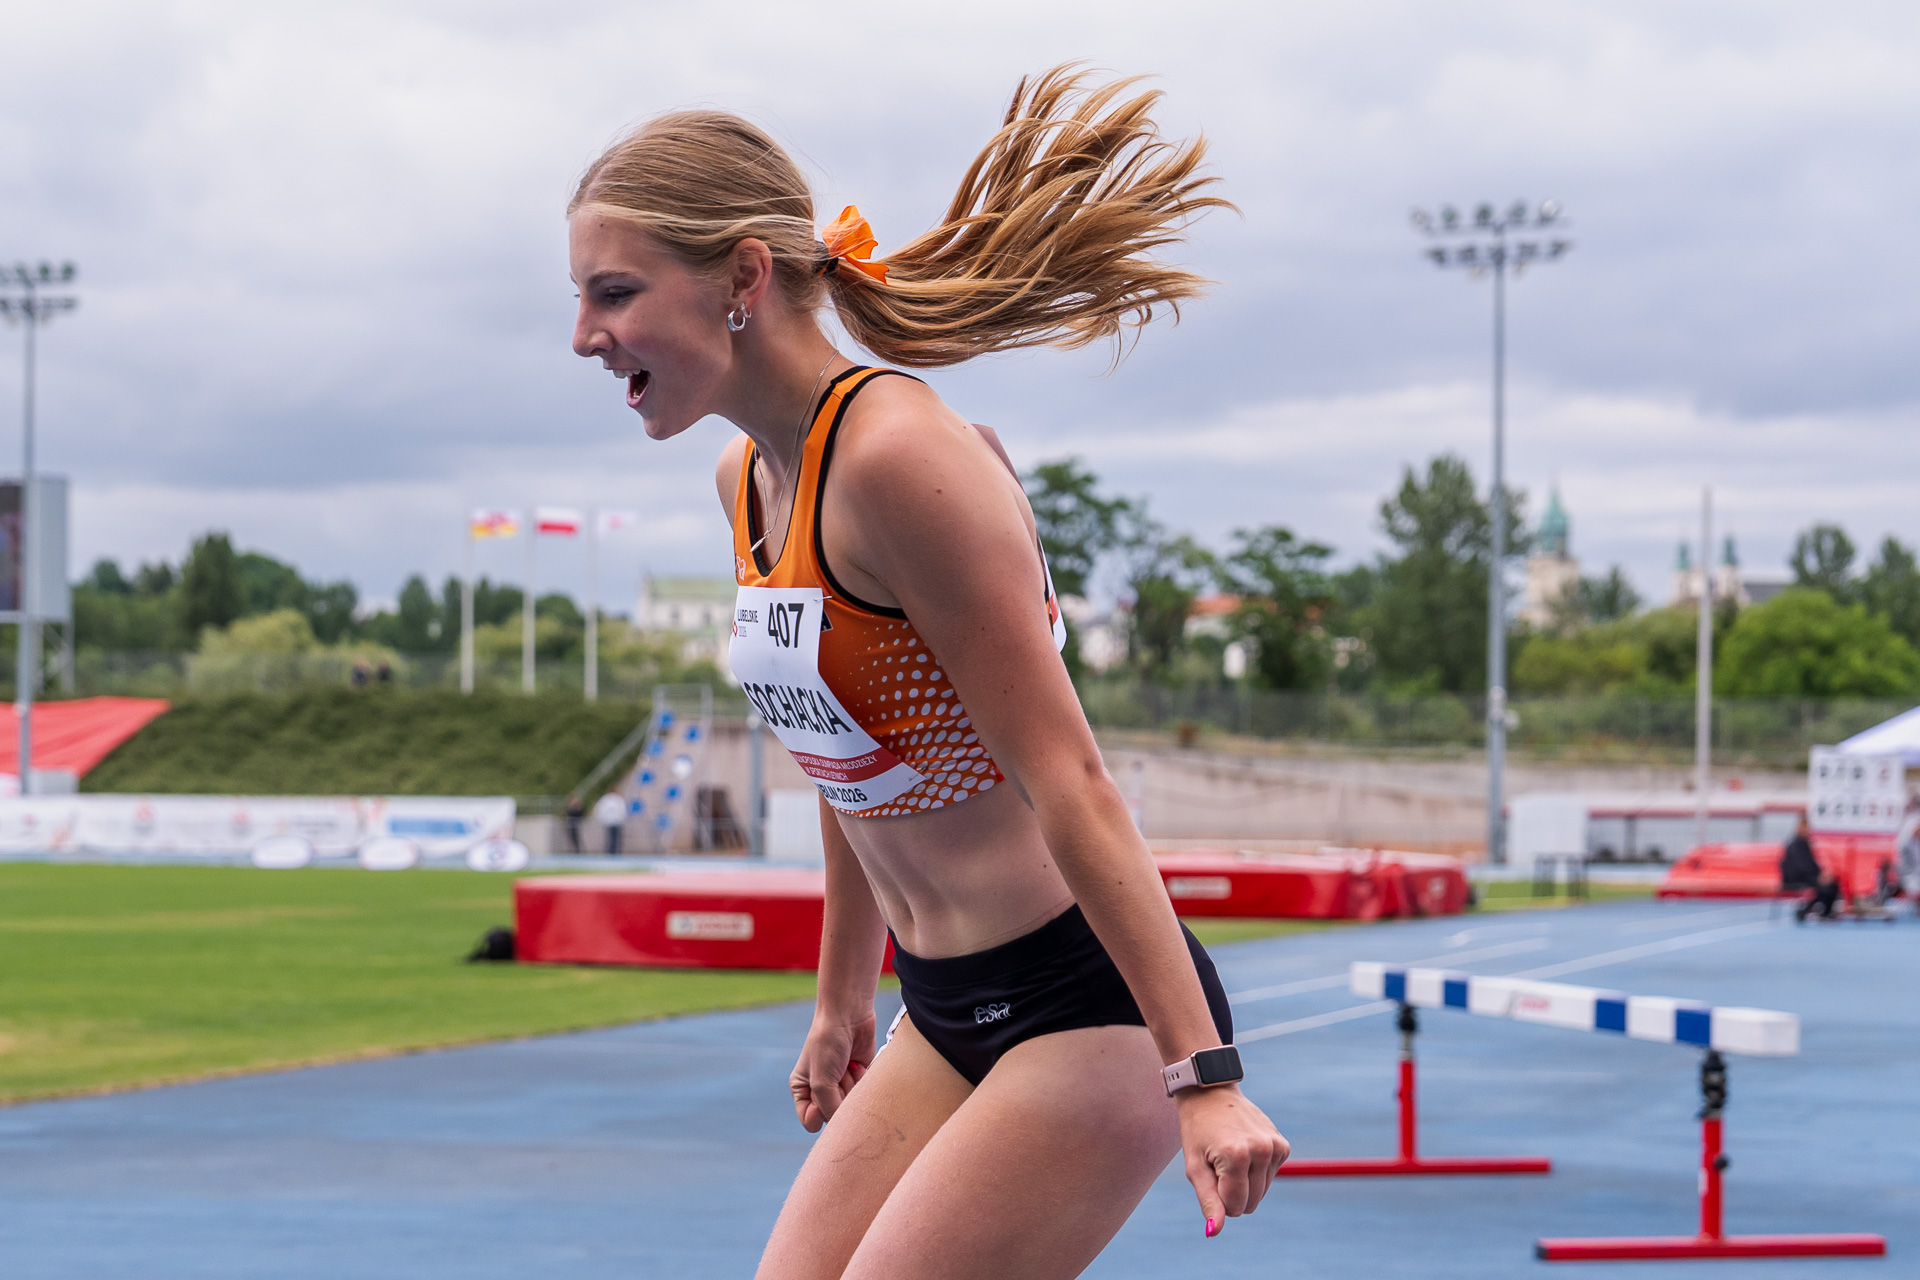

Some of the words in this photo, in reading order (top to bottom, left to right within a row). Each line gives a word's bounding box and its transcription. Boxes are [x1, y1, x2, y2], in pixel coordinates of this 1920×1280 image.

[768, 602, 805, 648] 407
[743, 681, 853, 735] SOCHACKA
[840, 754, 878, 770] MŁODZIEŻY
[837, 787, 869, 803] 2026
